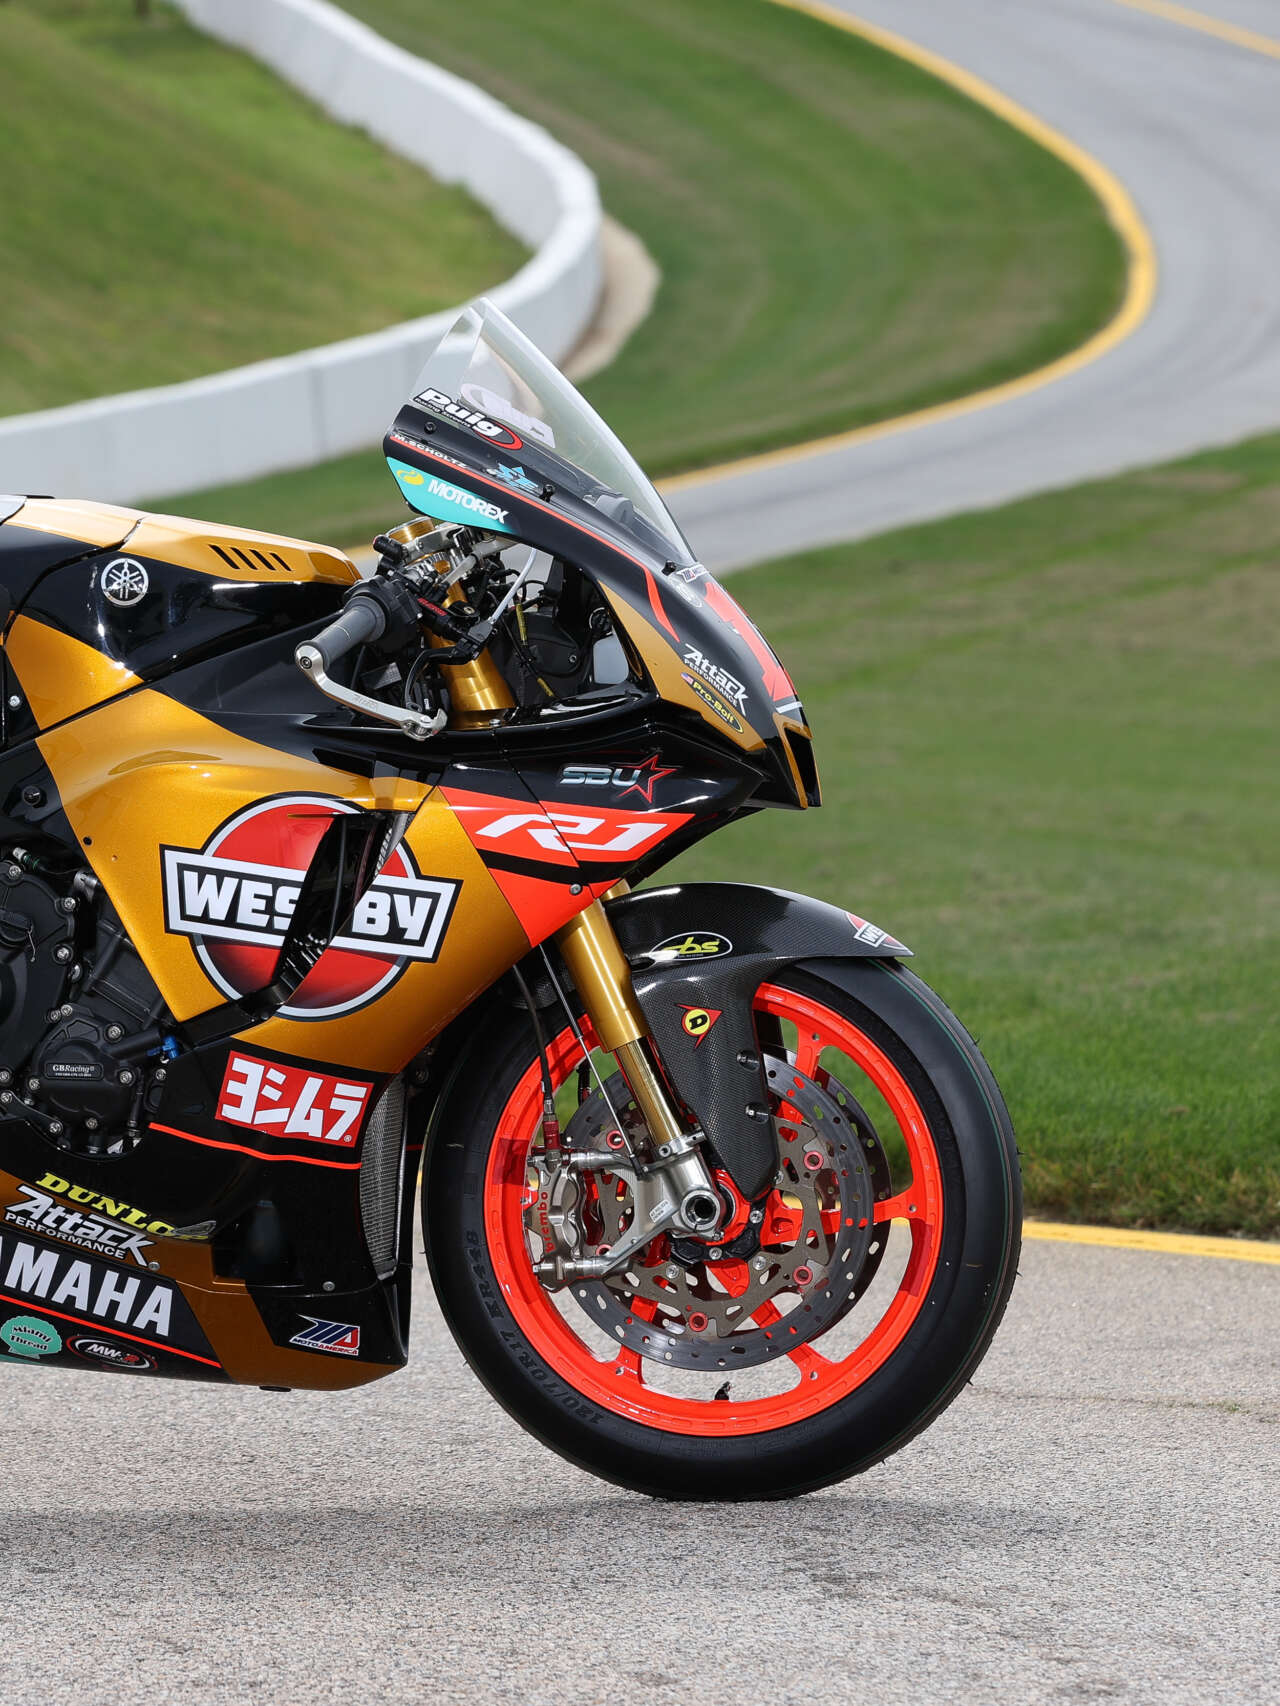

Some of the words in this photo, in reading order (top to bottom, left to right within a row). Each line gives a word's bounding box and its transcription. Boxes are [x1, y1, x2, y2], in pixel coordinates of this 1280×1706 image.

[417, 387, 505, 437] Puig
[427, 479, 509, 524] MOTOREX
[683, 643, 749, 717] Attack
[684, 659, 738, 707] PERFORMANCE
[693, 682, 735, 723] Pro-Bolt
[182, 870, 432, 941] WESBY
[221, 1057, 368, 1141] ヨシムラ
[6, 1185, 156, 1267] Attack
[35, 1172, 209, 1240] DUNLO
[537, 1191, 556, 1253] brembo
[4, 1212, 126, 1260] PERFORMANCE
[291, 1337, 358, 1355] MOTOAMERICA
